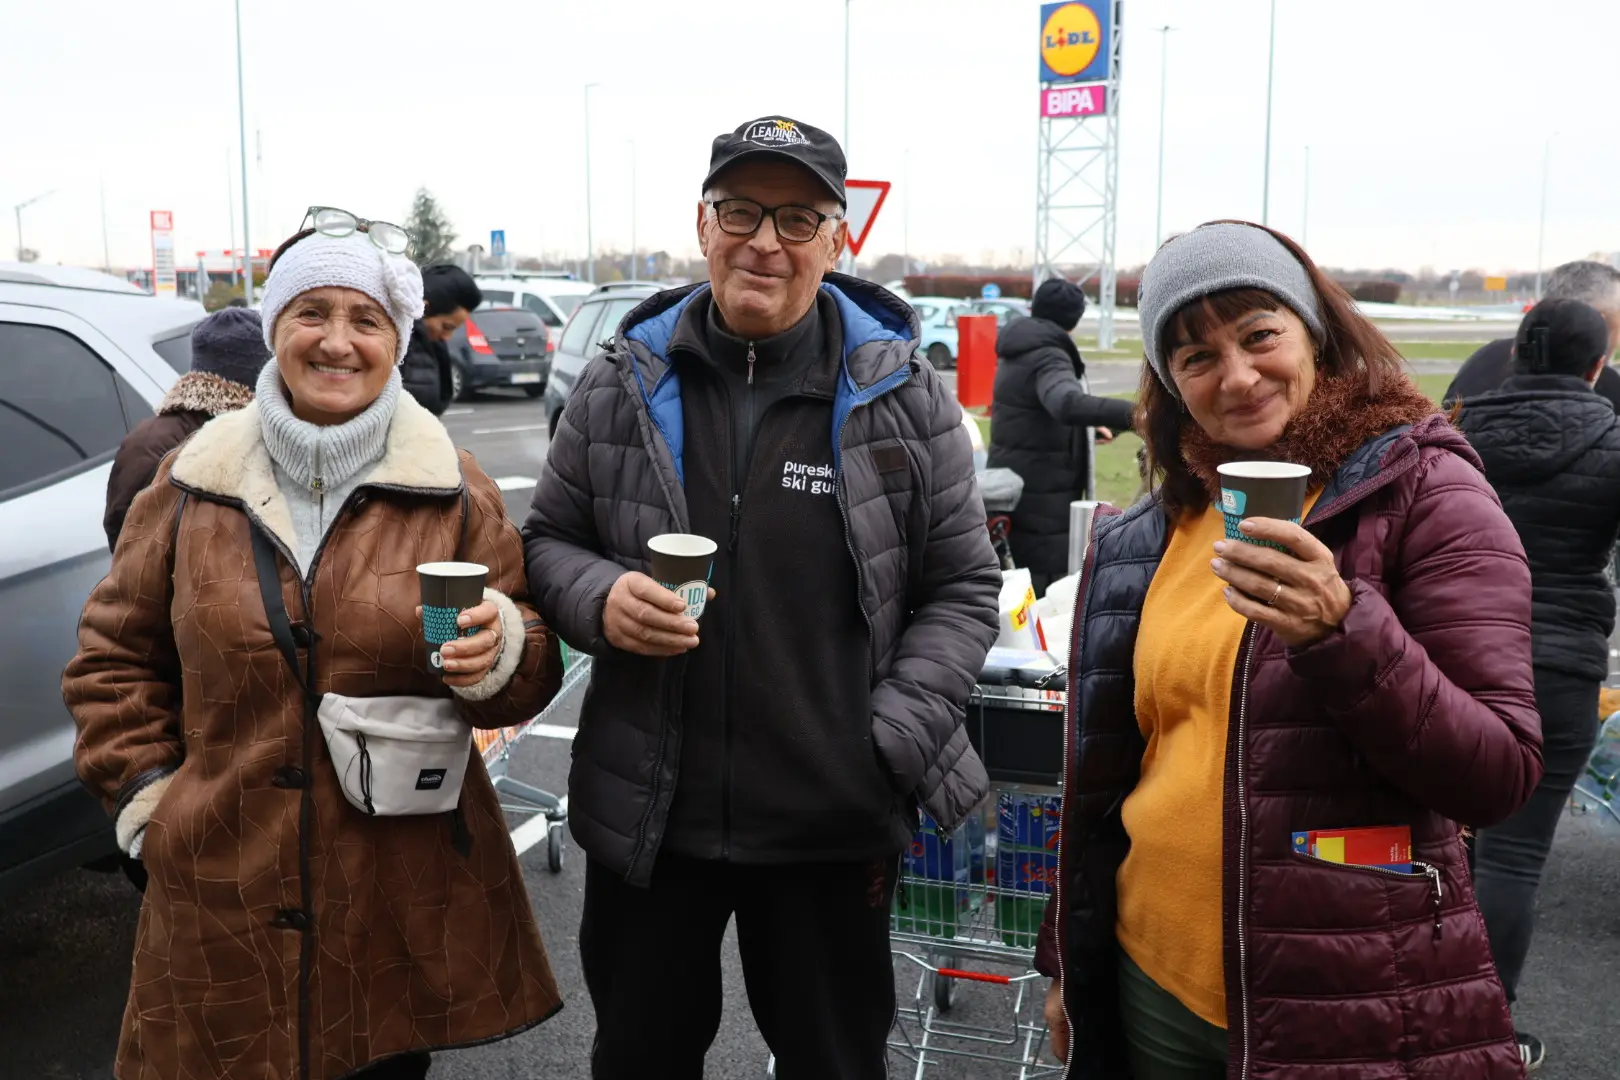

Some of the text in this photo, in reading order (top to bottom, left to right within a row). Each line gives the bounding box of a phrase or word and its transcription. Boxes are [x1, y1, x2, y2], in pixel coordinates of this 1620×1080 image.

[1046, 88, 1095, 115] BIPA
[751, 125, 797, 139] LEADING
[781, 474, 807, 491] ski
